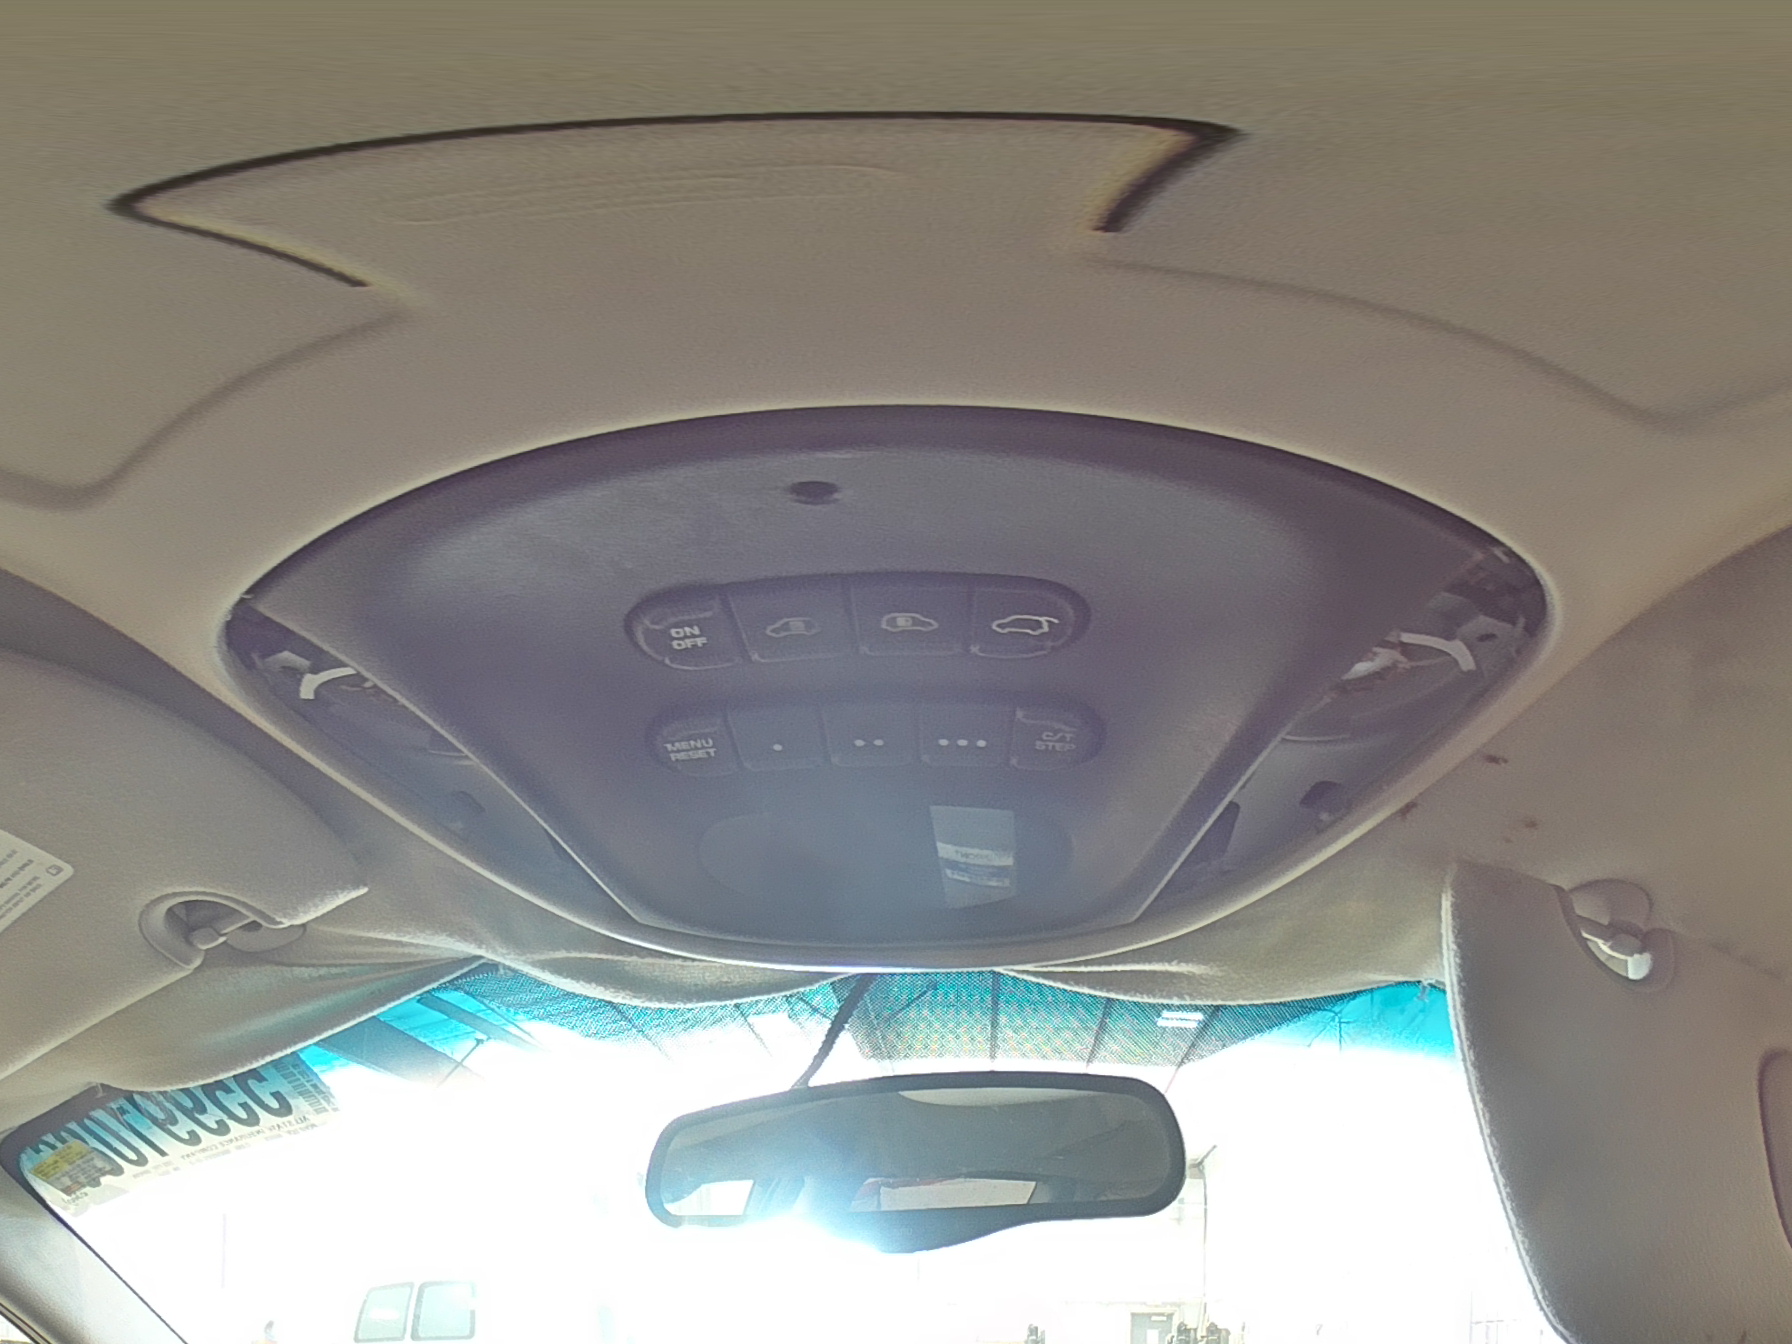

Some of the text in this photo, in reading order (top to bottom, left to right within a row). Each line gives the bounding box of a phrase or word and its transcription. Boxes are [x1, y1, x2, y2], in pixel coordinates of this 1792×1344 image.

[670, 625, 700, 638] ON
[671, 637, 708, 650] OFF
[664, 738, 714, 751] MENU
[1035, 740, 1076, 751] STEP
[669, 748, 717, 761] RESET
